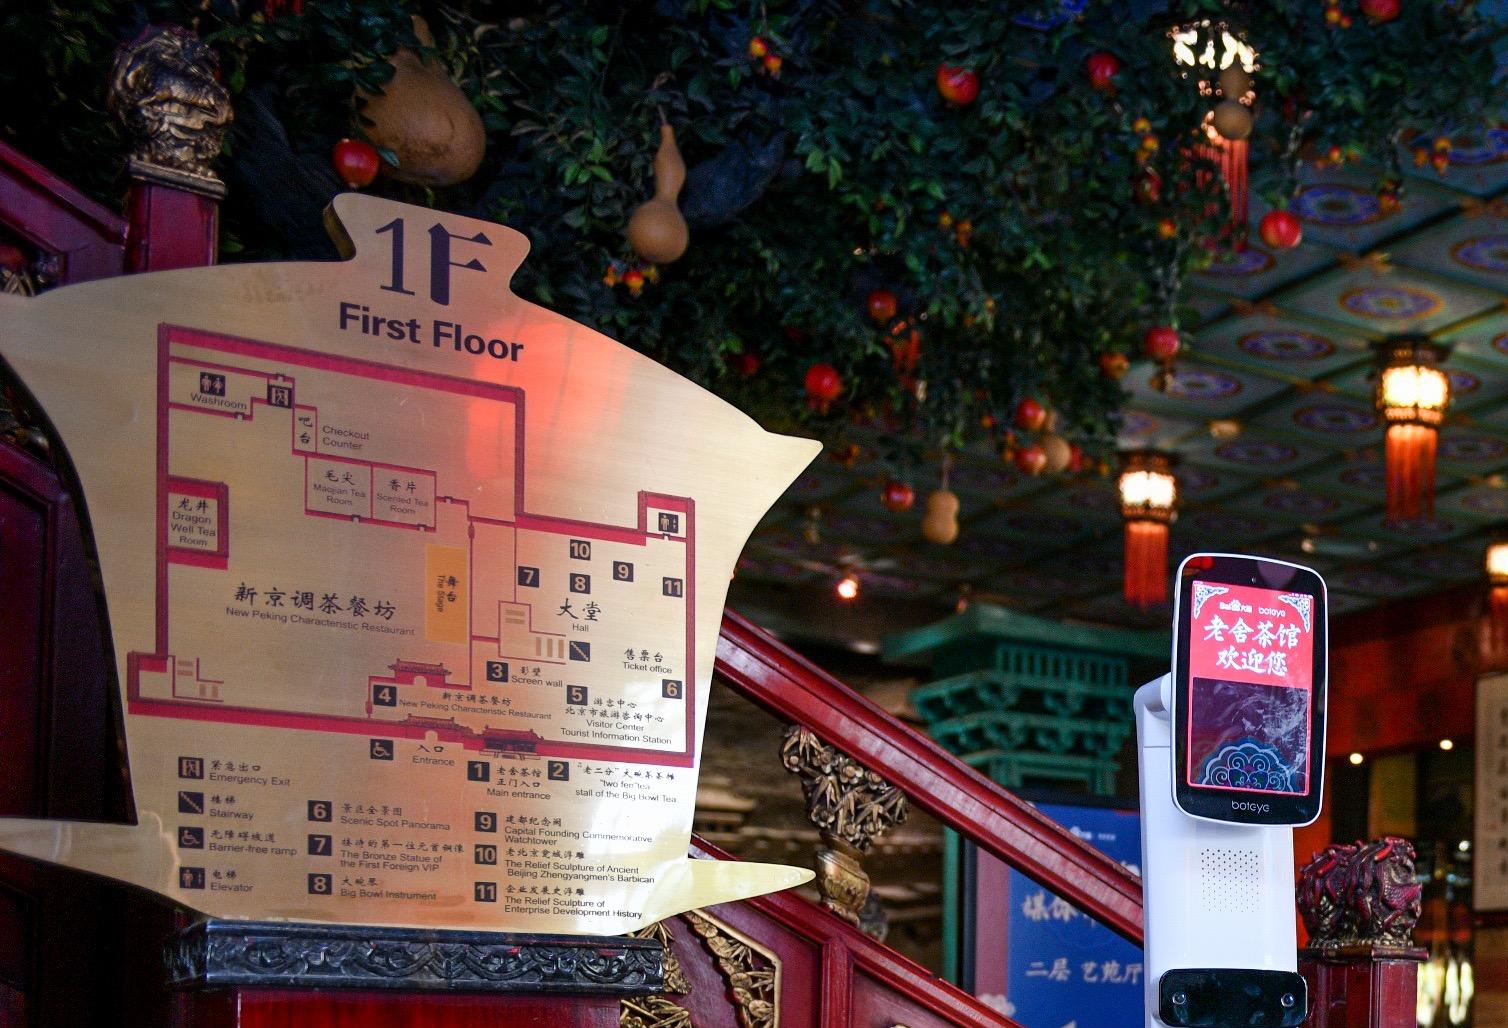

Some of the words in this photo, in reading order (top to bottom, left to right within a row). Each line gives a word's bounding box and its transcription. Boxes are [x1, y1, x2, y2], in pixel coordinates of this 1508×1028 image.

[375, 217, 493, 306] 1F
[339, 301, 421, 344] First
[432, 319, 524, 362] Floor
[190, 392, 247, 410] Washroom
[298, 416, 313, 444] 吧台
[322, 425, 370, 441] Checkout
[322, 436, 362, 451] Counter
[325, 469, 356, 487] 毛尖
[313, 483, 348, 499] Maojian
[350, 487, 366, 498] Tea
[388, 478, 417, 495] 香片
[178, 497, 210, 514] 龙井
[326, 495, 353, 507] Room
[376, 492, 412, 505] Scented
[413, 496, 429, 508] Tea
[389, 504, 416, 516] Room
[172, 511, 212, 526] Dragon
[170, 523, 195, 535] Well
[196, 525, 216, 537] Tea
[179, 535, 208, 547] Room
[571, 542, 590, 559] 10
[523, 569, 535, 585] 7
[617, 564, 629, 580] 9
[437, 574, 446, 589] The
[574, 576, 586, 592] 8
[664, 580, 682, 596] 11
[233, 581, 397, 621] 新京调茶餐坊
[436, 590, 445, 613] Stage
[556, 598, 602, 622] 大堂
[226, 606, 250, 619] New
[252, 610, 287, 624] Peking
[290, 614, 358, 631] Characteristic
[361, 622, 415, 636] Restaurant
[572, 623, 590, 632] Hall
[1203, 614, 1301, 650] 老舍茶馆
[623, 648, 664, 663] 售票台
[1215, 645, 1288, 677] 欢迎您
[491, 663, 503, 680] 3
[520, 666, 542, 677] 影壁
[622, 661, 648, 672] Ticket
[649, 664, 673, 674] office
[511, 675, 543, 687] Screen
[546, 678, 563, 687] wall
[377, 687, 392, 703] 4
[571, 687, 583, 703] 5
[666, 682, 678, 697] 6
[441, 691, 512, 707] 新京调茶餐坊
[593, 698, 637, 709] 游客中心
[399, 699, 418, 709] New
[420, 701, 449, 712] Peking
[450, 703, 507, 717] Characteristic
[508, 709, 552, 720] Restaurant
[586, 719, 613, 729] Visitor
[615, 721, 644, 732] Center
[561, 727, 590, 738] Tourist
[592, 730, 640, 742] Information
[642, 735, 672, 745] Station
[417, 744, 444, 753] 入口
[210, 760, 261, 772] 紧急出口
[412, 755, 455, 767] Entrance
[473, 763, 483, 778] 1
[496, 765, 542, 778] 老舍茶馆
[552, 763, 564, 778] 2
[209, 772, 267, 786] Emergency
[271, 776, 290, 787] Exit
[497, 778, 541, 788] 正门入口
[210, 793, 236, 805] 楼梯
[487, 787, 509, 797] Main
[511, 790, 551, 801] entrance
[575, 789, 593, 797] stall
[595, 790, 604, 798] of
[606, 791, 620, 799] the
[622, 792, 636, 802] Big
[638, 793, 659, 801] Bowl
[662, 795, 677, 803] Tea
[209, 808, 254, 821] Stairway
[313, 803, 327, 819] 6
[341, 803, 402, 816] 景区全景图
[1231, 800, 1270, 815] boteye
[340, 816, 373, 826] Scenic
[376, 818, 398, 828] Spot
[401, 820, 450, 831] Panorama
[480, 814, 492, 830] 9
[210, 829, 276, 843] 无障碍坡道
[504, 826, 536, 837] Capital
[538, 829, 580, 840] Founding
[582, 831, 653, 843] Commemorative
[505, 835, 557, 846] Watchtower
[209, 842, 268, 855] Barrier-free
[270, 847, 298, 857] ramp
[314, 837, 326, 853] 7
[341, 850, 359, 859] The
[362, 851, 397, 861] Bronze
[399, 853, 430, 863] Statue
[433, 855, 443, 863] of
[476, 847, 496, 862] 10
[340, 859, 355, 868] the
[359, 860, 380, 869] First
[383, 861, 420, 872] Foreign
[422, 863, 440, 872] VIP
[505, 859, 522, 868] The
[524, 860, 551, 870] Relief
[552, 861, 594, 873] Sculpture
[596, 864, 605, 872] of
[607, 865, 639, 874] Ancient
[212, 869, 237, 880] 电梯
[507, 868, 538, 880] Beijing
[540, 870, 615, 882] Zhengyangmen's
[617, 874, 655, 884] Barbican
[210, 882, 254, 892] Elevator
[313, 876, 327, 892] 8
[505, 884, 585, 896] 企业发展史浮雕
[340, 888, 356, 899] Big
[360, 889, 382, 898] Bowl
[385, 890, 437, 901] Instrument
[477, 884, 495, 900] 11
[505, 895, 522, 904] The
[524, 896, 551, 906] Relief
[552, 898, 594, 909] Sculpture
[596, 900, 605, 908] of
[504, 904, 550, 915] Enterprise
[552, 907, 610, 918] Development
[612, 909, 643, 920] History
[1024, 957, 1072, 982] 二层
